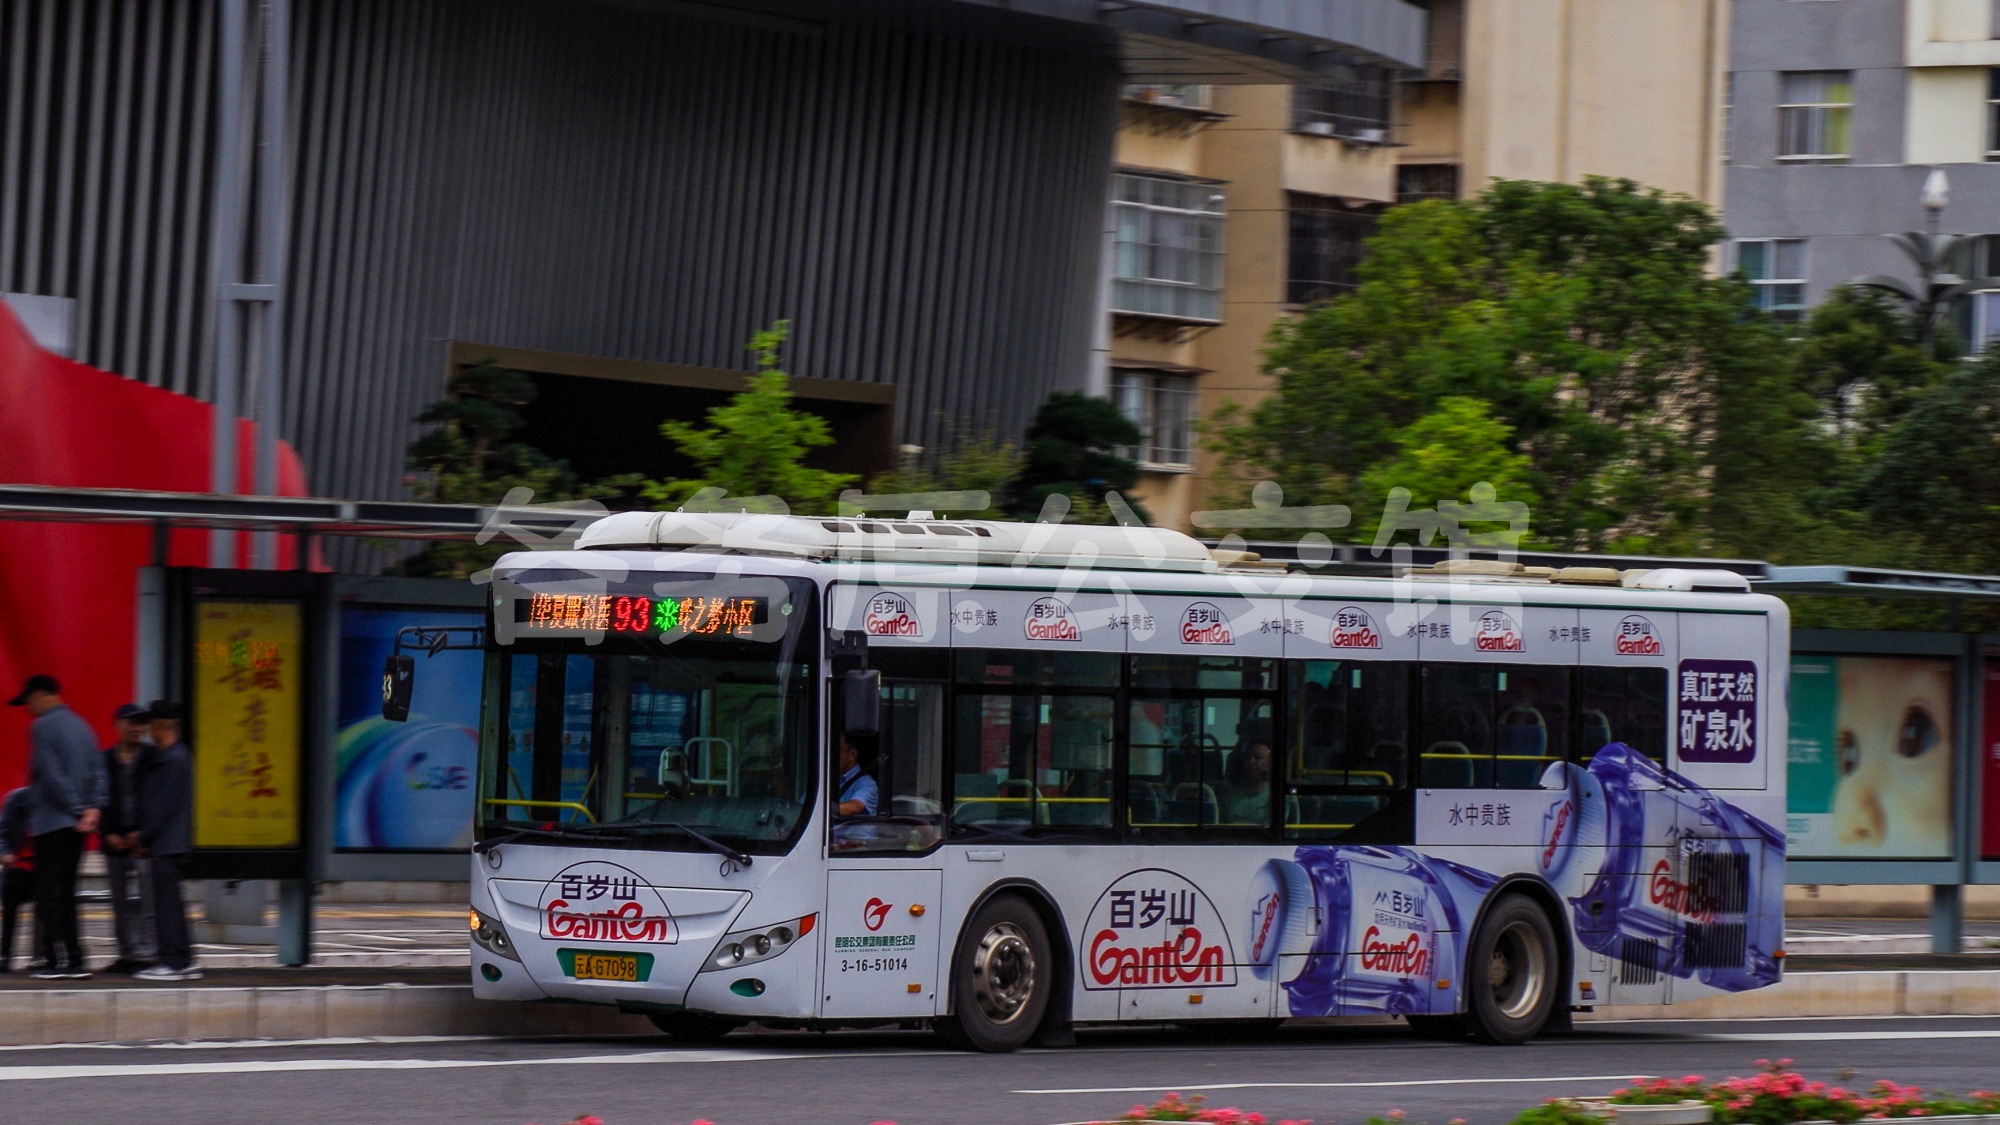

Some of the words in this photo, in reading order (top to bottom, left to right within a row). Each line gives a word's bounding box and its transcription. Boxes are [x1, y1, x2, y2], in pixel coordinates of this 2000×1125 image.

[614, 596, 650, 632] 93
[873, 598, 906, 614] 百岁山
[1033, 603, 1066, 618] 百岁山
[950, 607, 998, 627] 水中贵族
[1107, 612, 1155, 631] 水中贵族
[1188, 608, 1220, 623] 百岁山
[1338, 613, 1368, 628] 百岁山
[1482, 617, 1512, 632] 百岁山
[1260, 618, 1305, 635] 水中贵族
[1407, 621, 1450, 639] 水中贵族
[1549, 626, 1591, 643] 水中贵族
[1622, 621, 1651, 635] 百岁山
[1681, 669, 1755, 703] 真正天然
[1681, 709, 1753, 752] 矿泉水
[1449, 802, 1511, 826] 水中贵族
[561, 873, 638, 901] 百岁山
[1110, 888, 1196, 929] 百岁山
[1392, 889, 1424, 918] 百岁山
[841, 957, 908, 972] 3-16-51014
